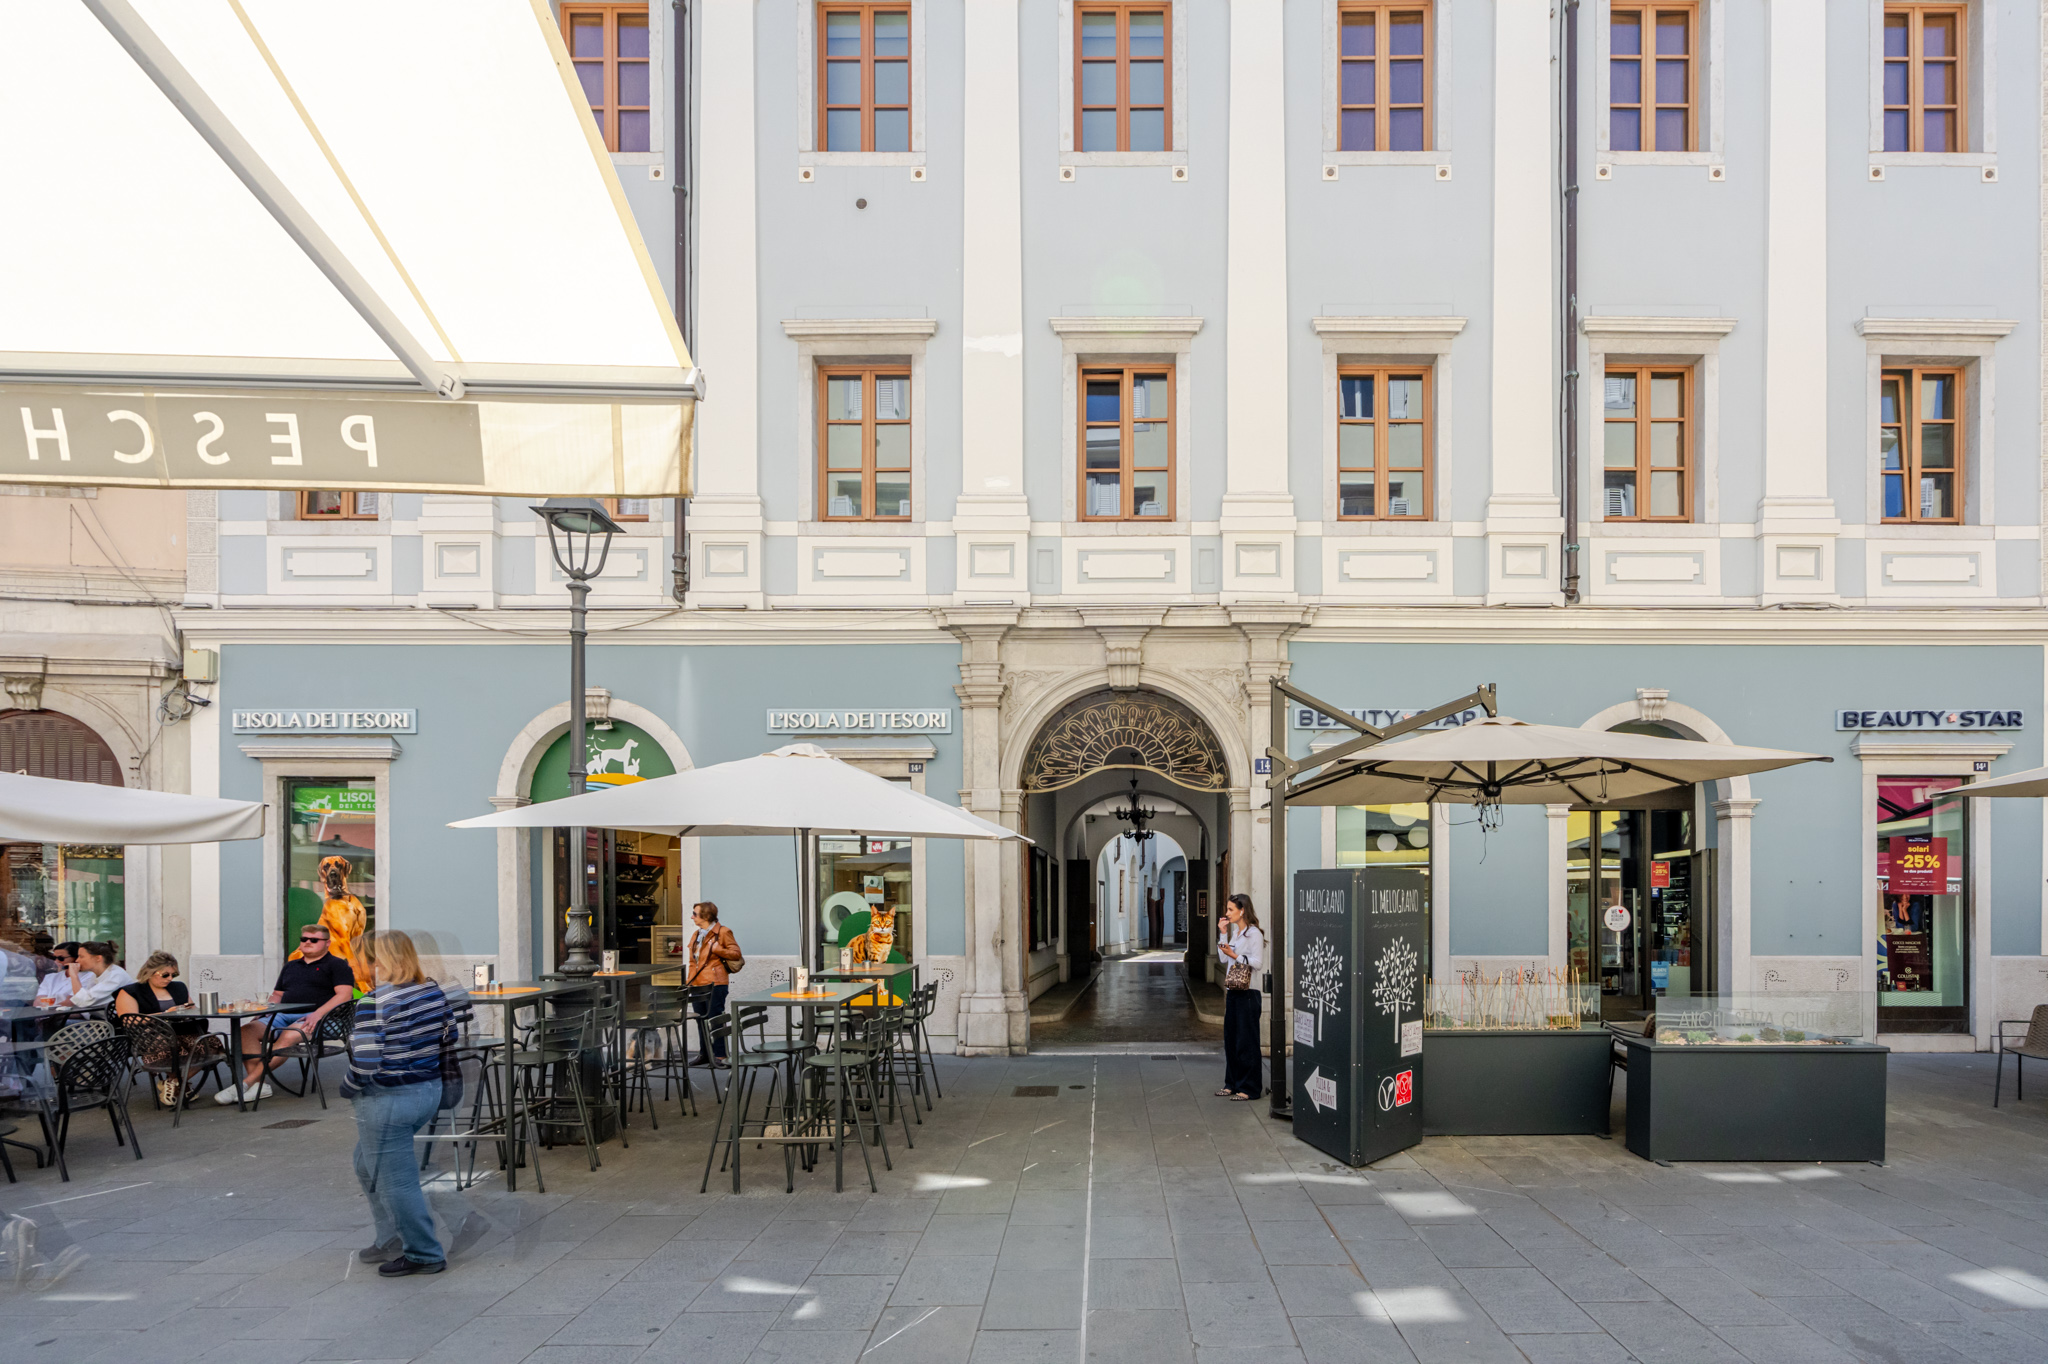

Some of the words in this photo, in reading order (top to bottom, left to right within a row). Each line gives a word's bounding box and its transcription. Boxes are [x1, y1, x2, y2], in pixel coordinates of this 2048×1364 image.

[232, 712, 302, 728] L'ISOLA
[306, 712, 338, 728] DEI
[343, 712, 410, 728] TESORI
[769, 712, 840, 728] L'ISOLA
[844, 712, 875, 728] DEI
[878, 712, 947, 728] TESORI
[1416, 709, 1477, 726] AR
[1843, 710, 1946, 728] BEAUTY
[1959, 710, 2023, 727] STAR
[1896, 854, 1941, 868] -25%
[1306, 889, 1345, 914] MELOGRANO
[1379, 889, 1419, 914] MELOGRANO
[1312, 1088, 1335, 1107] RESTAURANT
